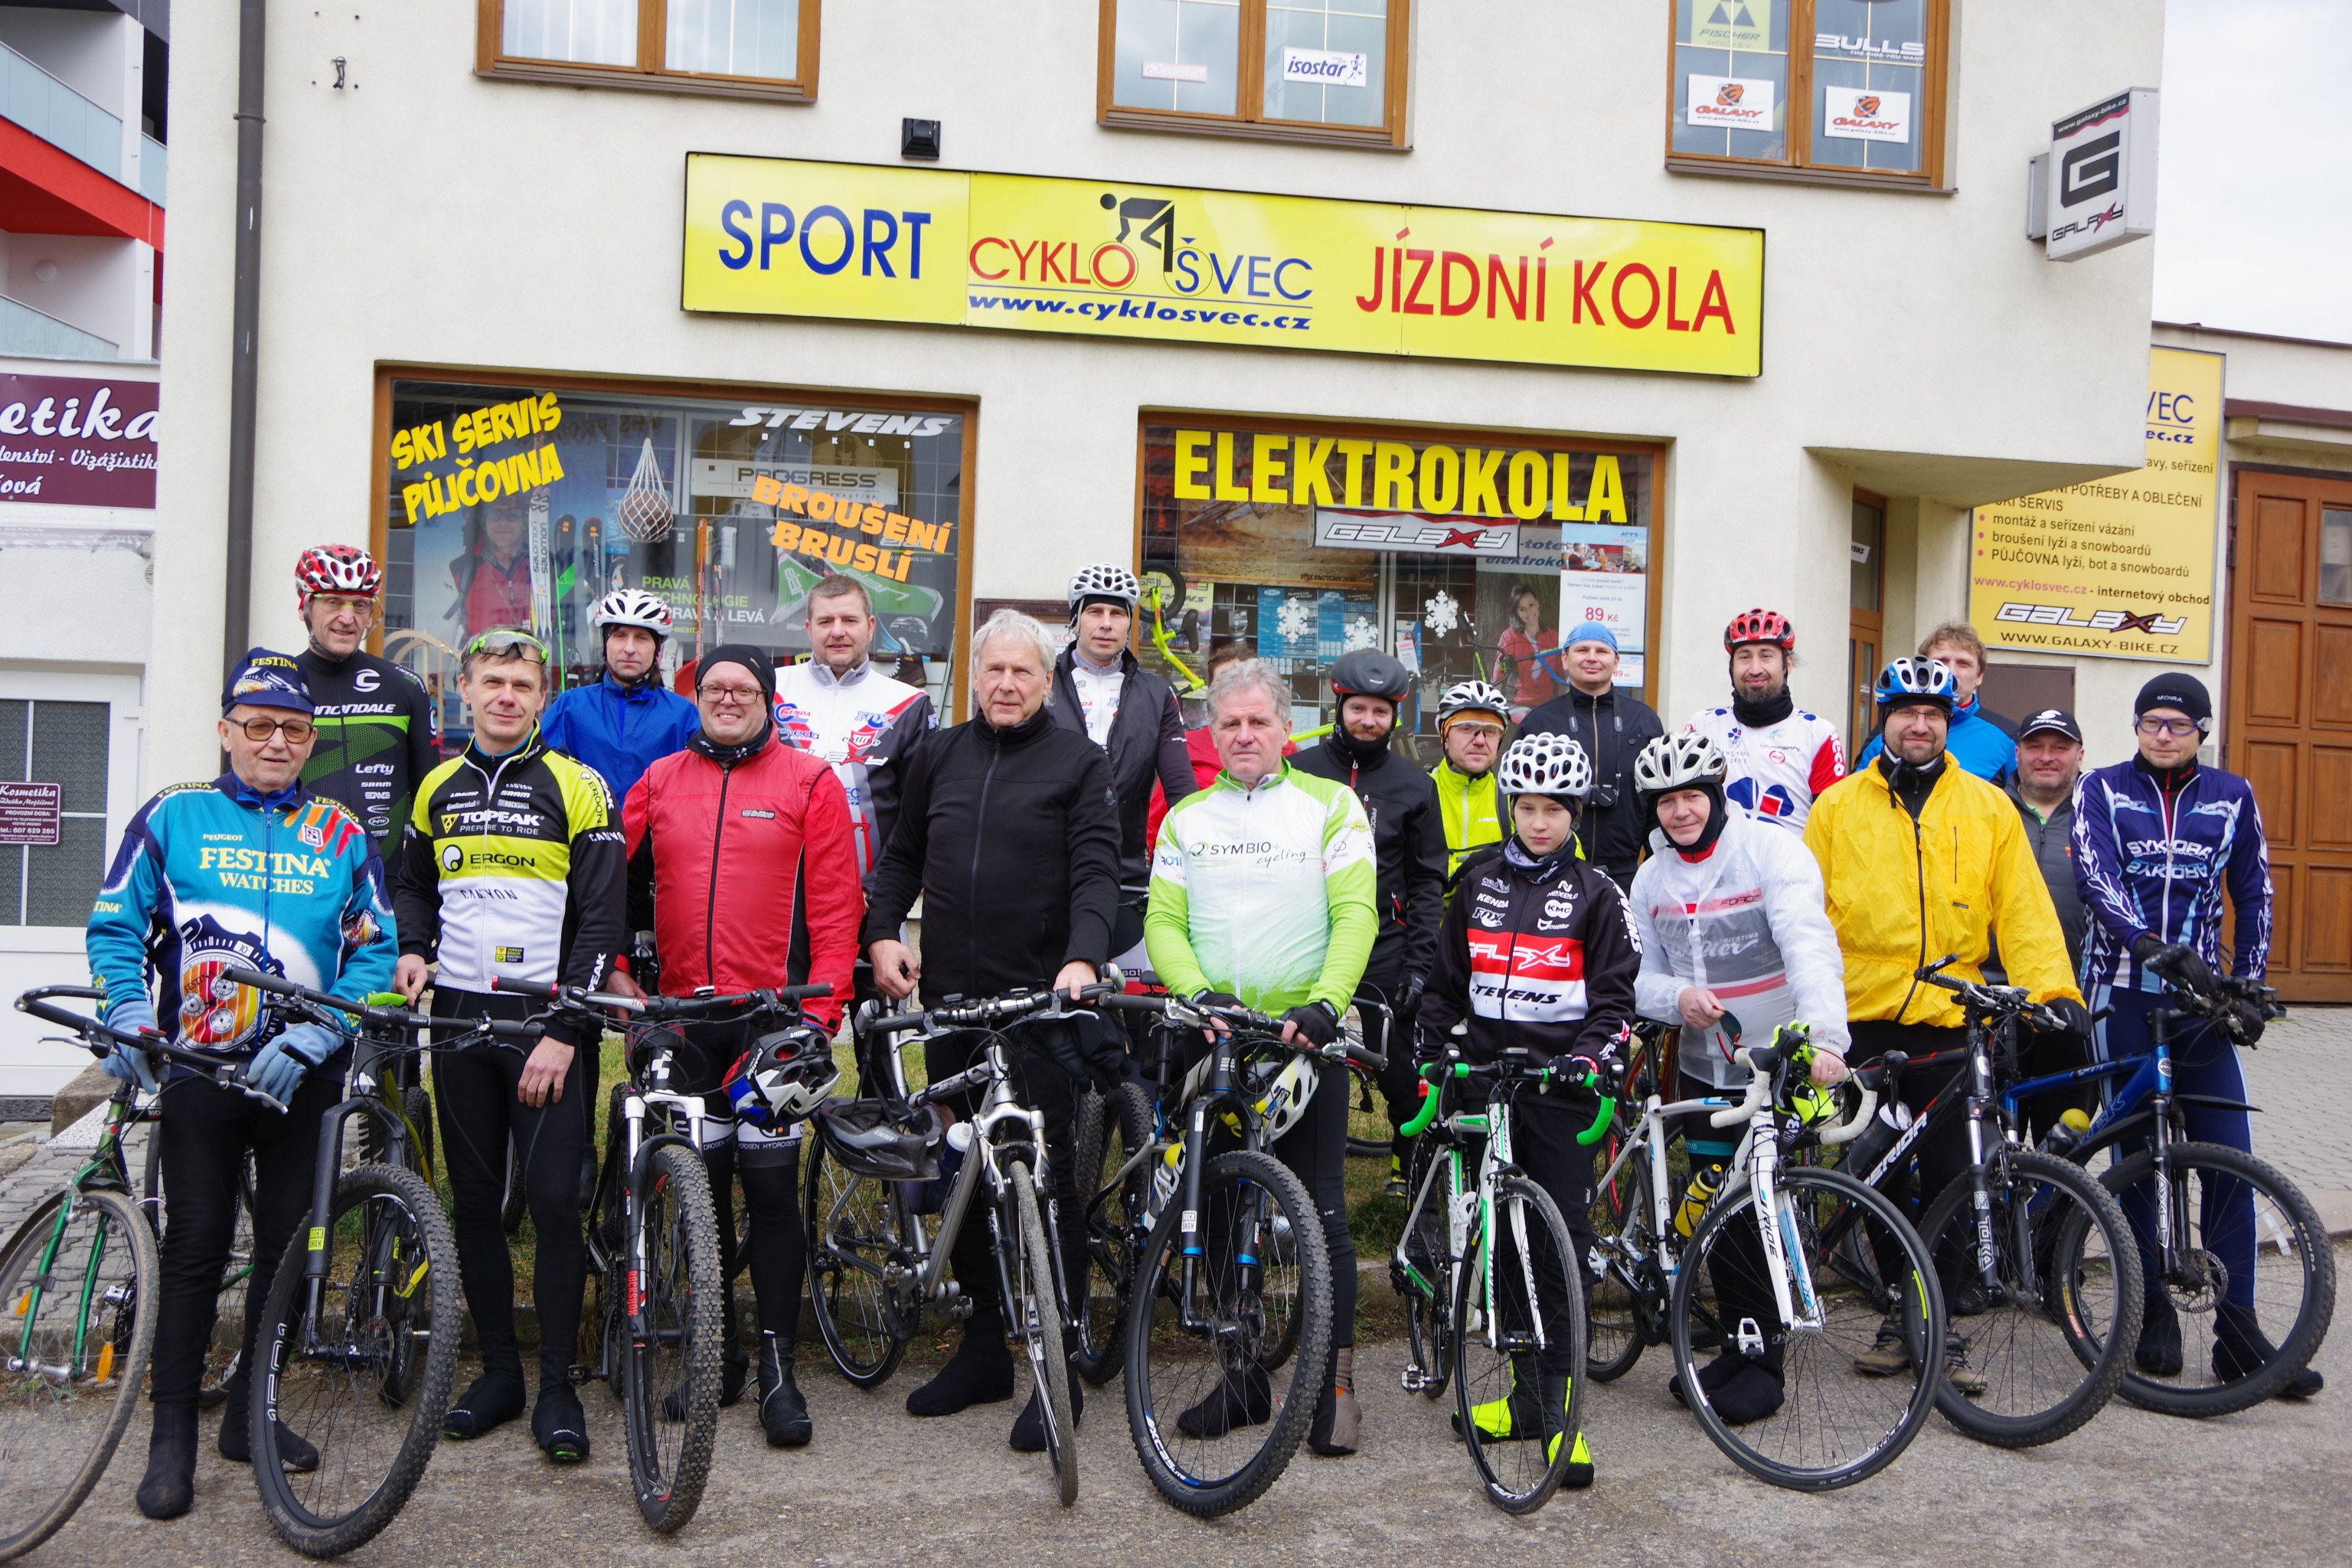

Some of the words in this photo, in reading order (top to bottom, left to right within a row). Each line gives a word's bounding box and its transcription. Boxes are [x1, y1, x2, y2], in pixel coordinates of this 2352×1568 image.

[1699, 29, 1762, 41] FISCHER
[1815, 34, 1925, 56] BULLS
[1287, 56, 1347, 77] isostar
[1695, 105, 1763, 118] GALAXY
[1833, 117, 1900, 129] GALAXY
[2058, 98, 2127, 133] www.galaxy-bike.cz
[2052, 201, 2124, 241] GALAXY
[719, 198, 931, 279] SPORT
[969, 237, 1136, 289] CYKLO
[1175, 237, 1313, 299] ŠVEC
[1356, 227, 1554, 322] JÍZDNÍ
[1573, 260, 1736, 335] KOLA
[969, 294, 1312, 331] www.cyklosvec.cz
[391, 420, 448, 471] SKI
[452, 391, 563, 456] SERVIS
[728, 407, 953, 437] STEVENS
[738, 467, 877, 488] PROGRESS
[1174, 429, 1628, 524] ELEKTROKOLA
[2171, 461, 2214, 475] seřízení
[402, 442, 565, 525] PŮJČOVNA
[2020, 496, 2063, 511] SERVIS
[2072, 483, 2128, 500] POTŘEBY
[2132, 491, 2140, 501] A
[2143, 490, 2203, 508] OBLEČENÍ
[751, 475, 955, 554] BROUŠENÍ
[1993, 514, 2037, 528] montáž
[2050, 519, 2096, 533] seřízení
[2099, 524, 2135, 537] vázání
[530, 521, 540, 573] salomon
[540, 521, 549, 574] salomon
[1324, 522, 1511, 550] GALAXY
[1992, 531, 2044, 547] broušení
[2047, 534, 2068, 550] lyží
[2081, 541, 2151, 557] snowboardů
[772, 520, 916, 582] BRUSLÍ
[1991, 547, 2059, 566] PŮJČOVNA
[2063, 555, 2086, 570] lyží,
[2089, 557, 2108, 570] bot
[2111, 563, 2118, 571] a
[2120, 560, 2190, 577] snowboardů
[642, 573, 691, 590] PRAVÁ
[1975, 577, 2087, 595] www.cyklosvec.cz
[2097, 585, 2165, 606] internetový
[2167, 590, 2210, 606] obchod
[728, 607, 765, 624] LEVÁ
[1586, 607, 1604, 621] 89
[1994, 602, 2187, 634] GALAXY
[2001, 632, 2179, 655] WWW.GALAXY-BIKE.CZ
[252, 656, 299, 672] FESTINA
[2157, 694, 2183, 703] MOIRA
[355, 763, 394, 776] Lefty
[157, 782, 213, 799] FESTINA
[500, 790, 531, 799] SRAM
[315, 795, 360, 824] FESTINA
[588, 781, 602, 824] ERGON
[460, 811, 541, 827] TOPEAK
[202, 833, 244, 842] PEUGEOT
[469, 853, 535, 867] ERGON
[1256, 849, 1308, 868] cycling
[2126, 839, 2213, 860] SYKORA
[199, 847, 330, 878] FESTINA
[219, 872, 314, 895] WATCHES
[1476, 893, 1510, 910] KENDA
[1547, 905, 1572, 913] KMC
[1721, 893, 1760, 906] FORCE
[1472, 906, 1507, 927] FOX
[763, 1139, 796, 1150] HYDROGEN
[1762, 1211, 1779, 1259] RIDE
[1977, 1215, 1994, 1272] TORA
[2298, 1221, 2317, 1272] KENDA
[627, 1271, 639, 1316] ROCKSHOX
